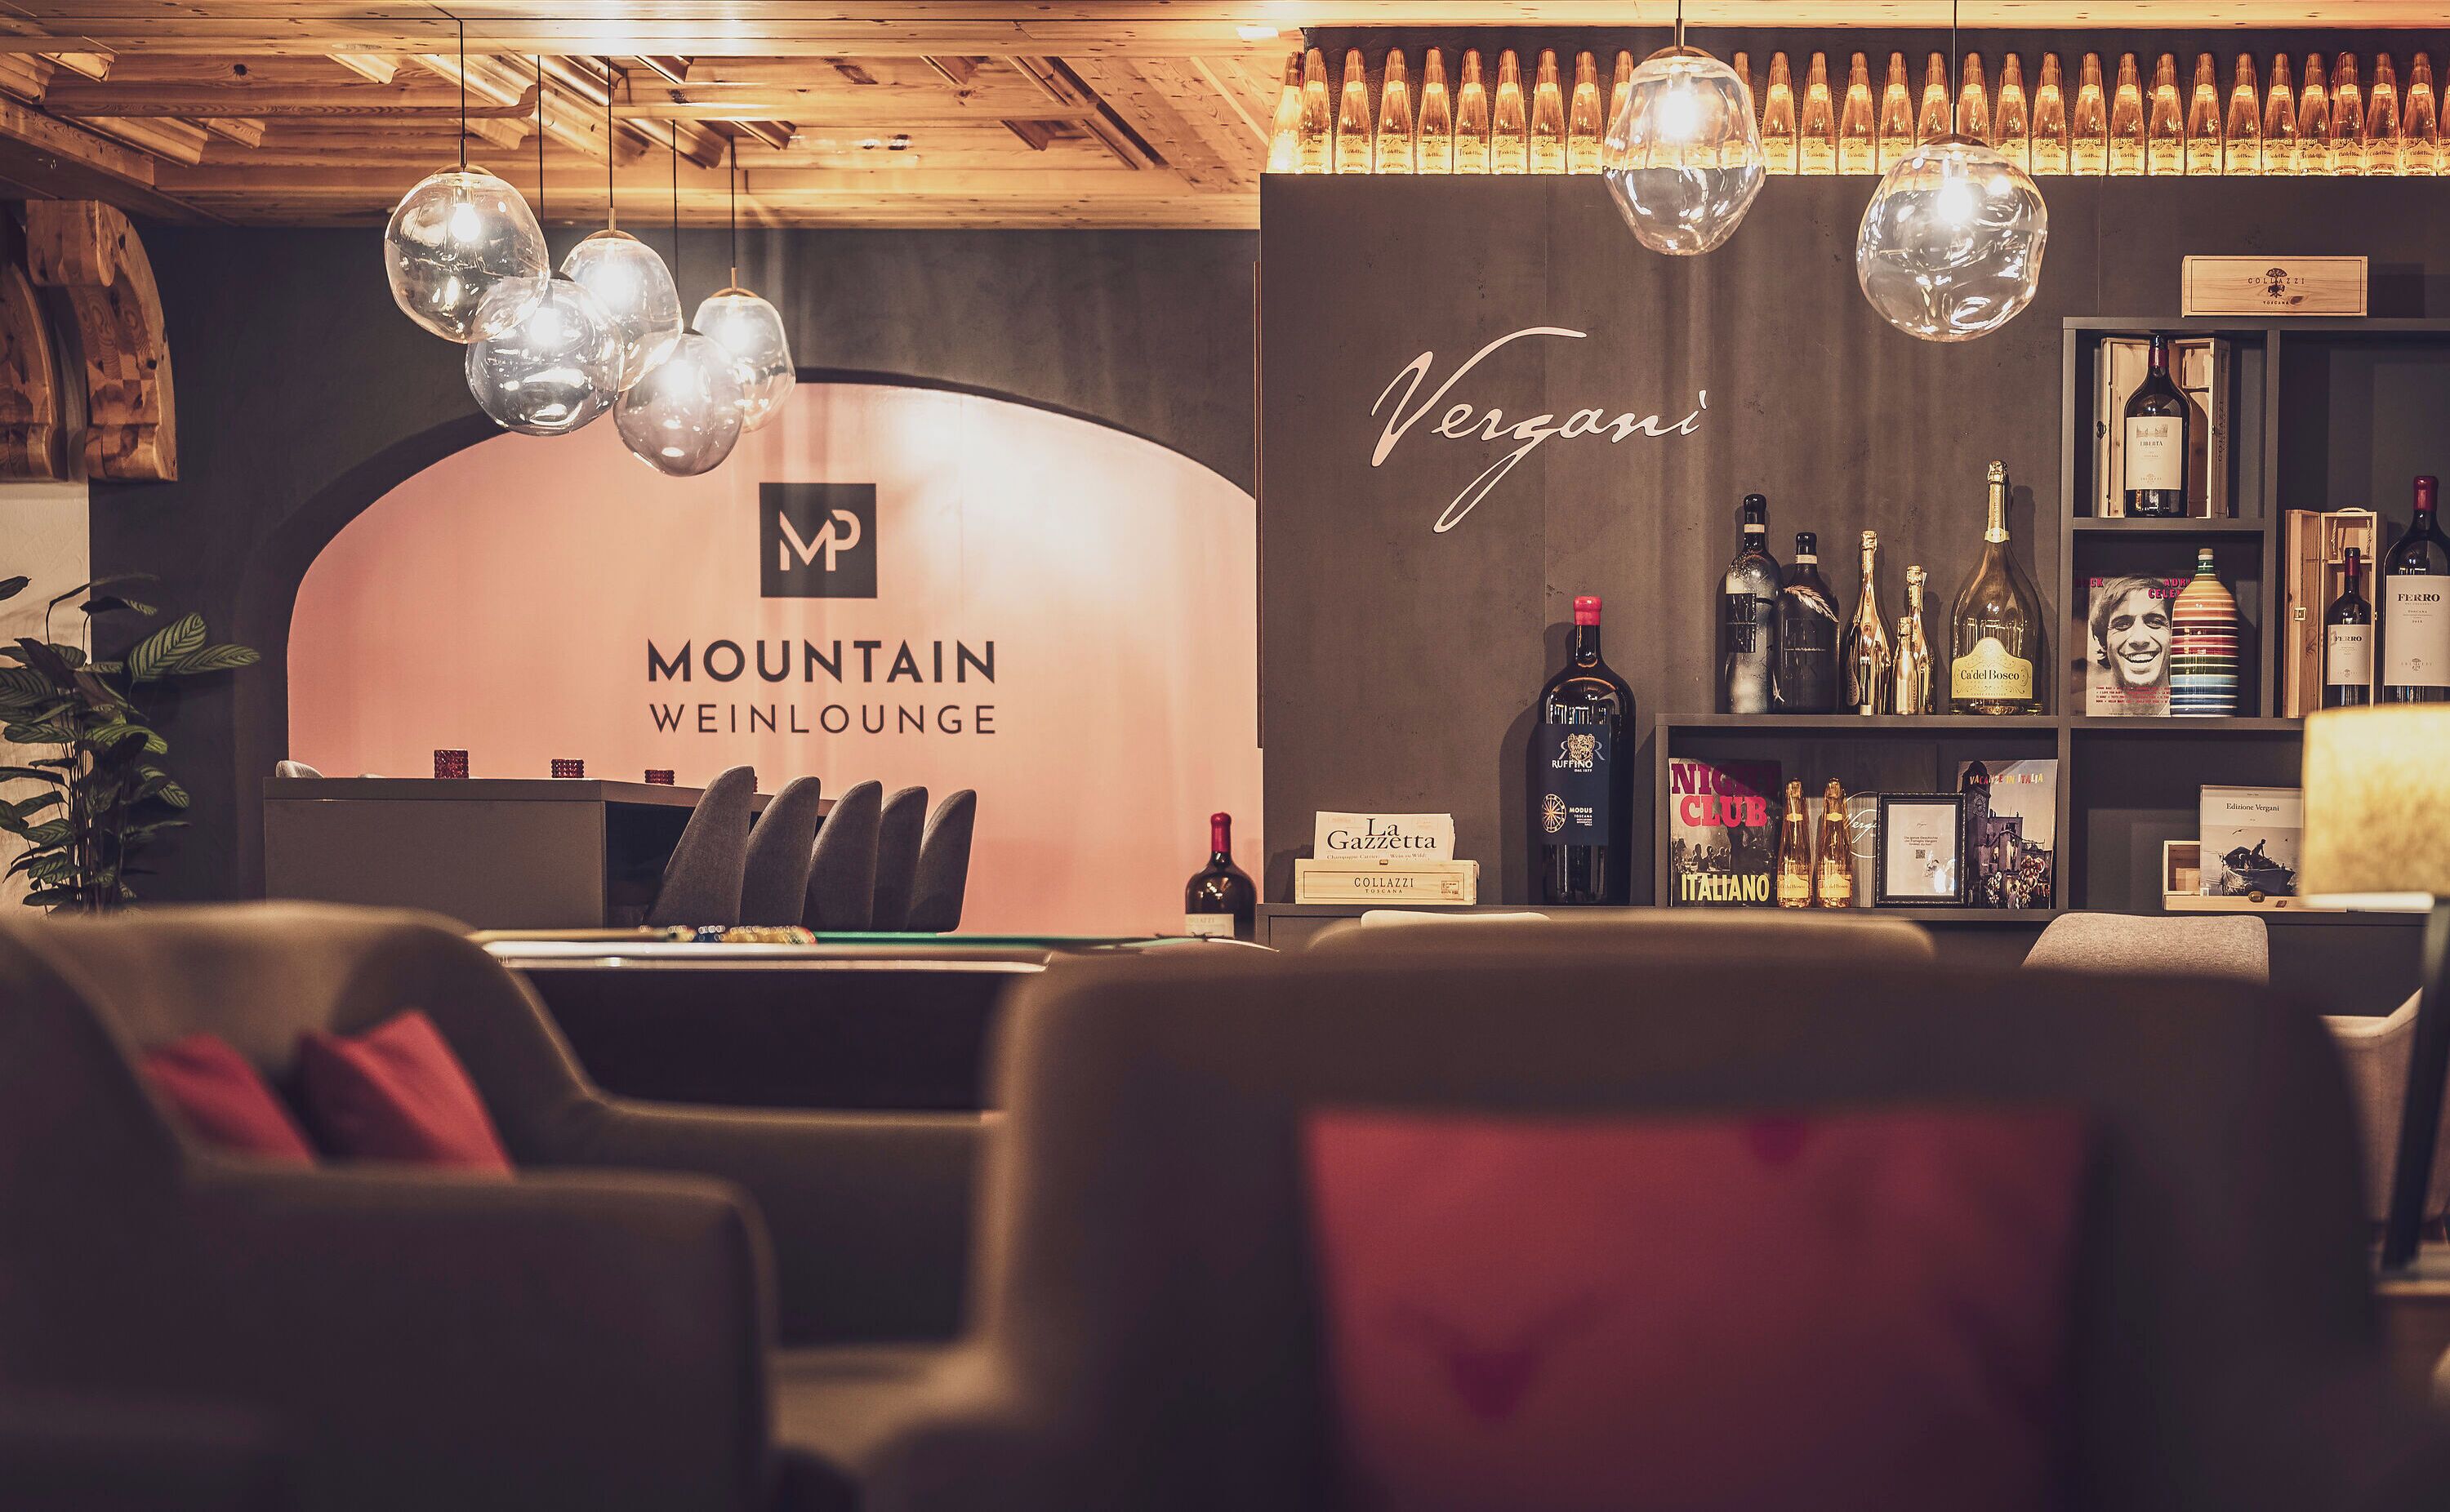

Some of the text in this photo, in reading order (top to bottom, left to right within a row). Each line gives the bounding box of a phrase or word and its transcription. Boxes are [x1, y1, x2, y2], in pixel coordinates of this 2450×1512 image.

[1371, 327, 1707, 533] Vergani
[779, 509, 862, 571] MP
[2398, 594, 2440, 602] FERRO
[648, 638, 995, 684] MOUNTAIN
[1989, 669, 2020, 680] Bosco
[649, 704, 996, 734] WEINLOUNGE
[1552, 760, 1593, 768] RUFFINO
[2018, 773, 2043, 784] ITALIA
[1680, 795, 1767, 828] CLUB
[2255, 804, 2279, 813] Vergani
[1365, 818, 1400, 837] La
[1327, 830, 1437, 850] Gazzetta
[1354, 877, 1414, 887] COLLAZZI
[1682, 874, 1770, 902] ITALIANO
